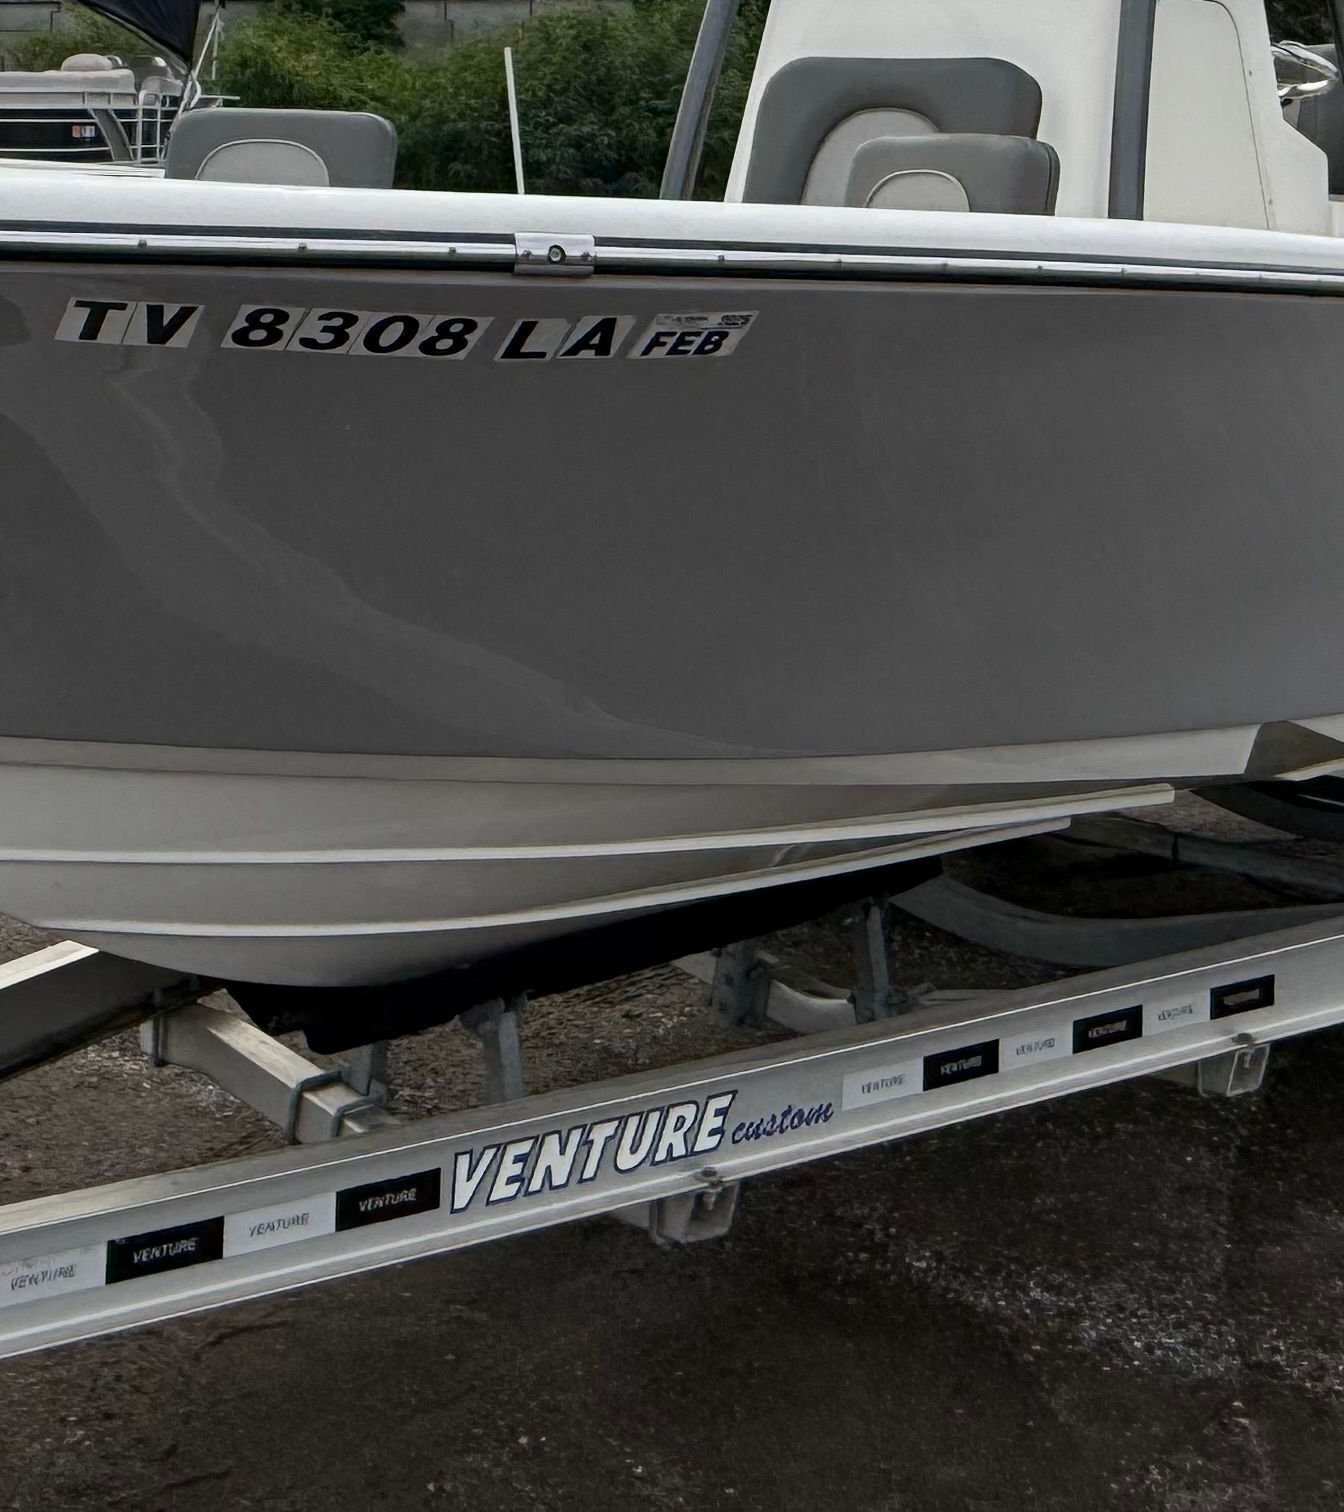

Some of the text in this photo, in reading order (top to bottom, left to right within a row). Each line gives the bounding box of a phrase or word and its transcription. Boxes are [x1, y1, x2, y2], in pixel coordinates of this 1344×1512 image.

[73, 300, 729, 359] TV 8308 LA FEB
[451, 1090, 834, 1214] VENTURE custom
[359, 1188, 417, 1212] VENTURE
[249, 1212, 310, 1237] VENTURE
[133, 1236, 199, 1264] VENTURE
